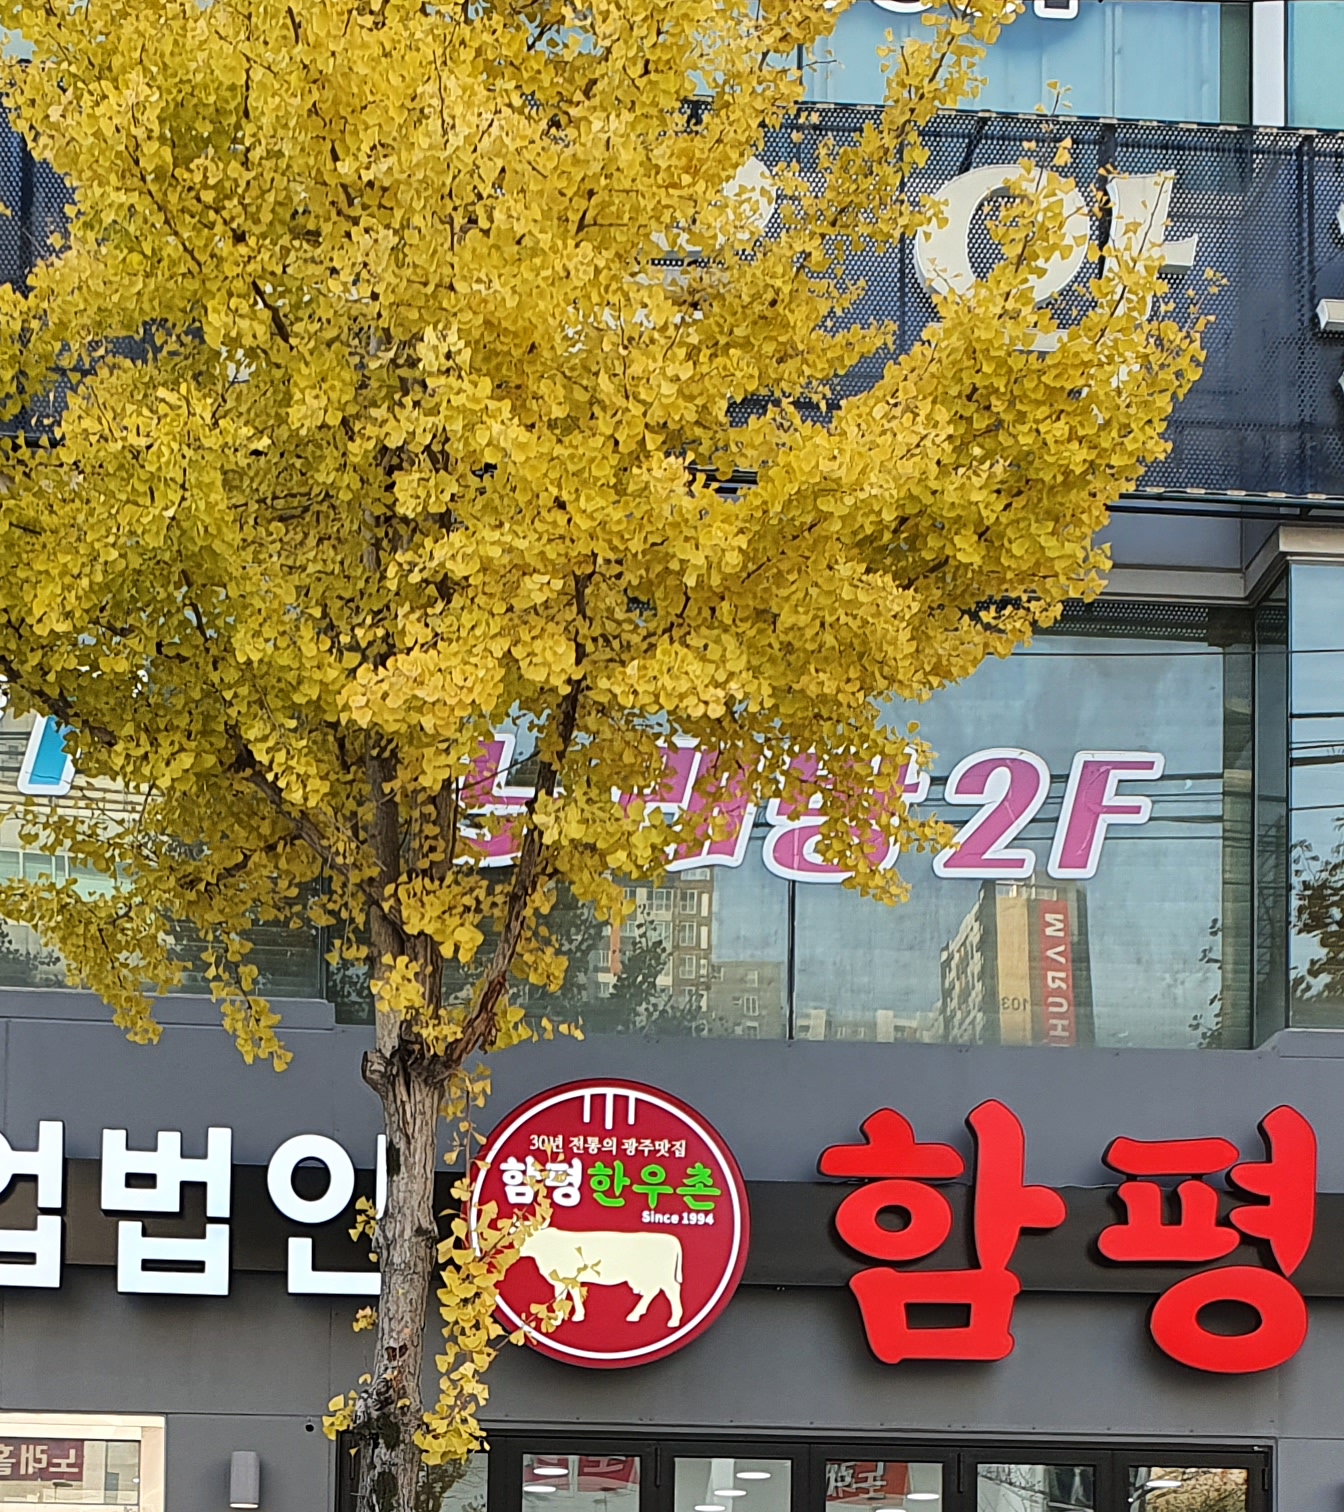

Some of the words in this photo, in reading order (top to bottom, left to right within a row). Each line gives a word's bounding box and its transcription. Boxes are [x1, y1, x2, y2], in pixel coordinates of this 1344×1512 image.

[569, 1137, 617, 1156] 전통의
[622, 1138, 687, 1159] 광주맛집
[641, 1210, 680, 1225] Since
[681, 1212, 715, 1226] 1994
[817, 1098, 1318, 1374] 함평
